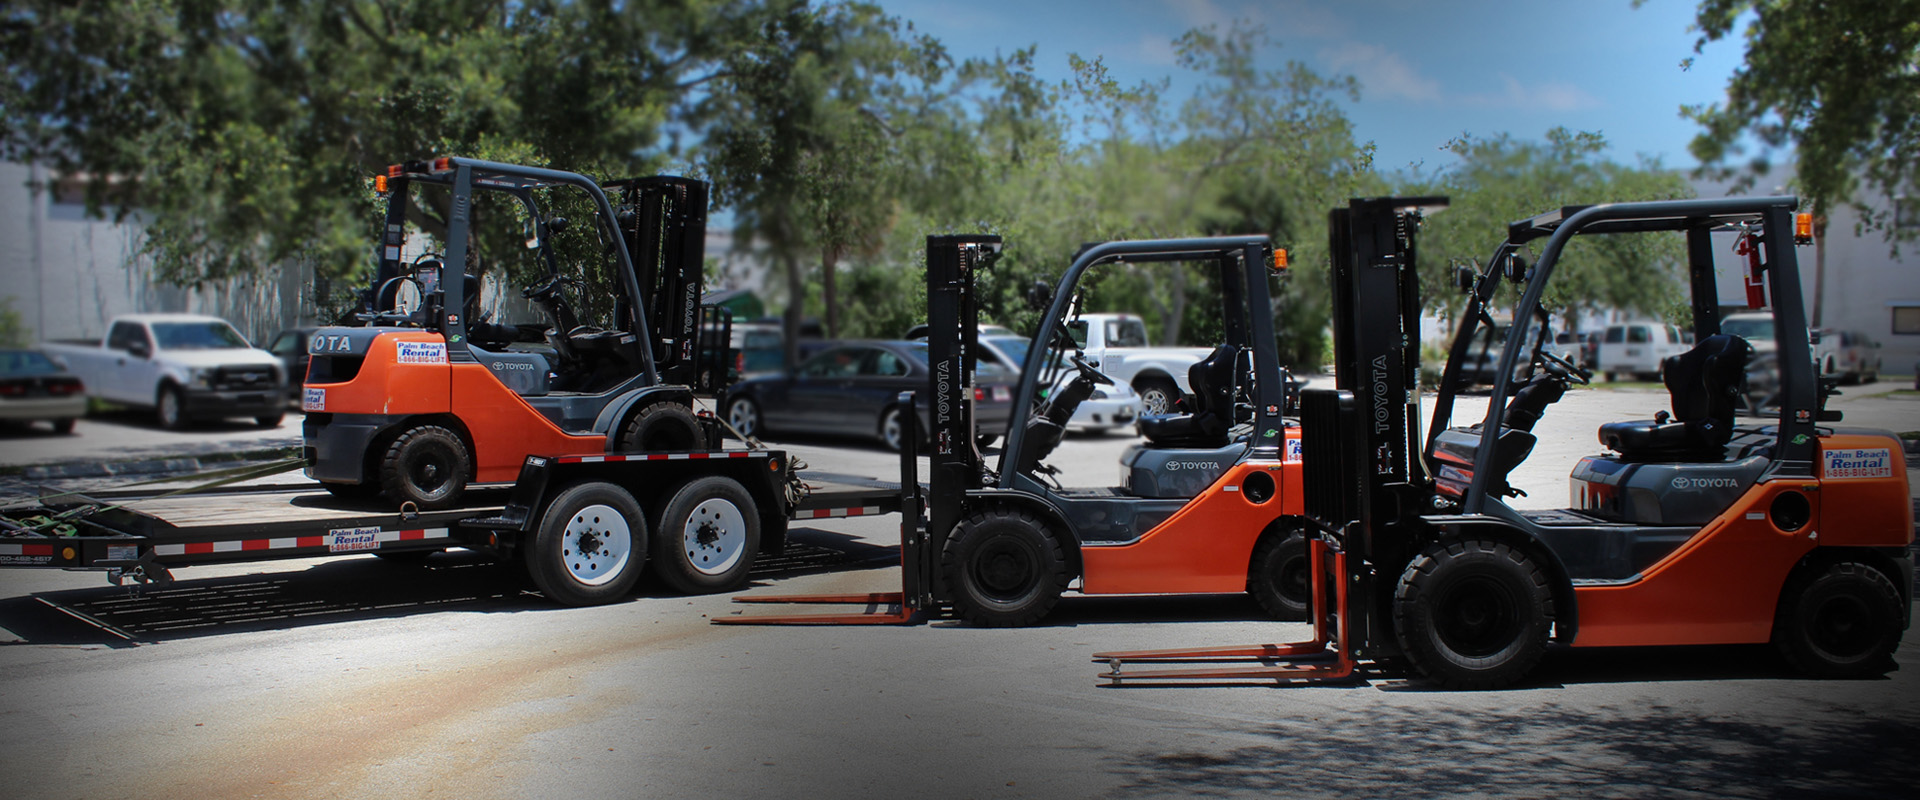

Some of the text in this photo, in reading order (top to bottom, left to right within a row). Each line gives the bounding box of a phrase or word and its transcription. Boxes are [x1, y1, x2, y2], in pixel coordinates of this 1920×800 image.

[683, 282, 696, 335] TOYOTA
[314, 335, 351, 351] OTA
[402, 349, 441, 357] Rental
[504, 362, 535, 370] TOYOTA
[937, 359, 950, 425] TOYOTA
[1372, 354, 1390, 435] TOYOTA
[1825, 450, 1889, 459] Palm Beach
[1181, 461, 1220, 470] TOYOTA
[1831, 458, 1883, 469] Rental
[1826, 468, 1889, 477] 1-866-BIG-LIFT
[1691, 478, 1739, 488] TOYOTA
[354, 528, 379, 536] Beach
[335, 534, 375, 544] Rental
[331, 541, 379, 551] 1-866-BIG-LIFT
